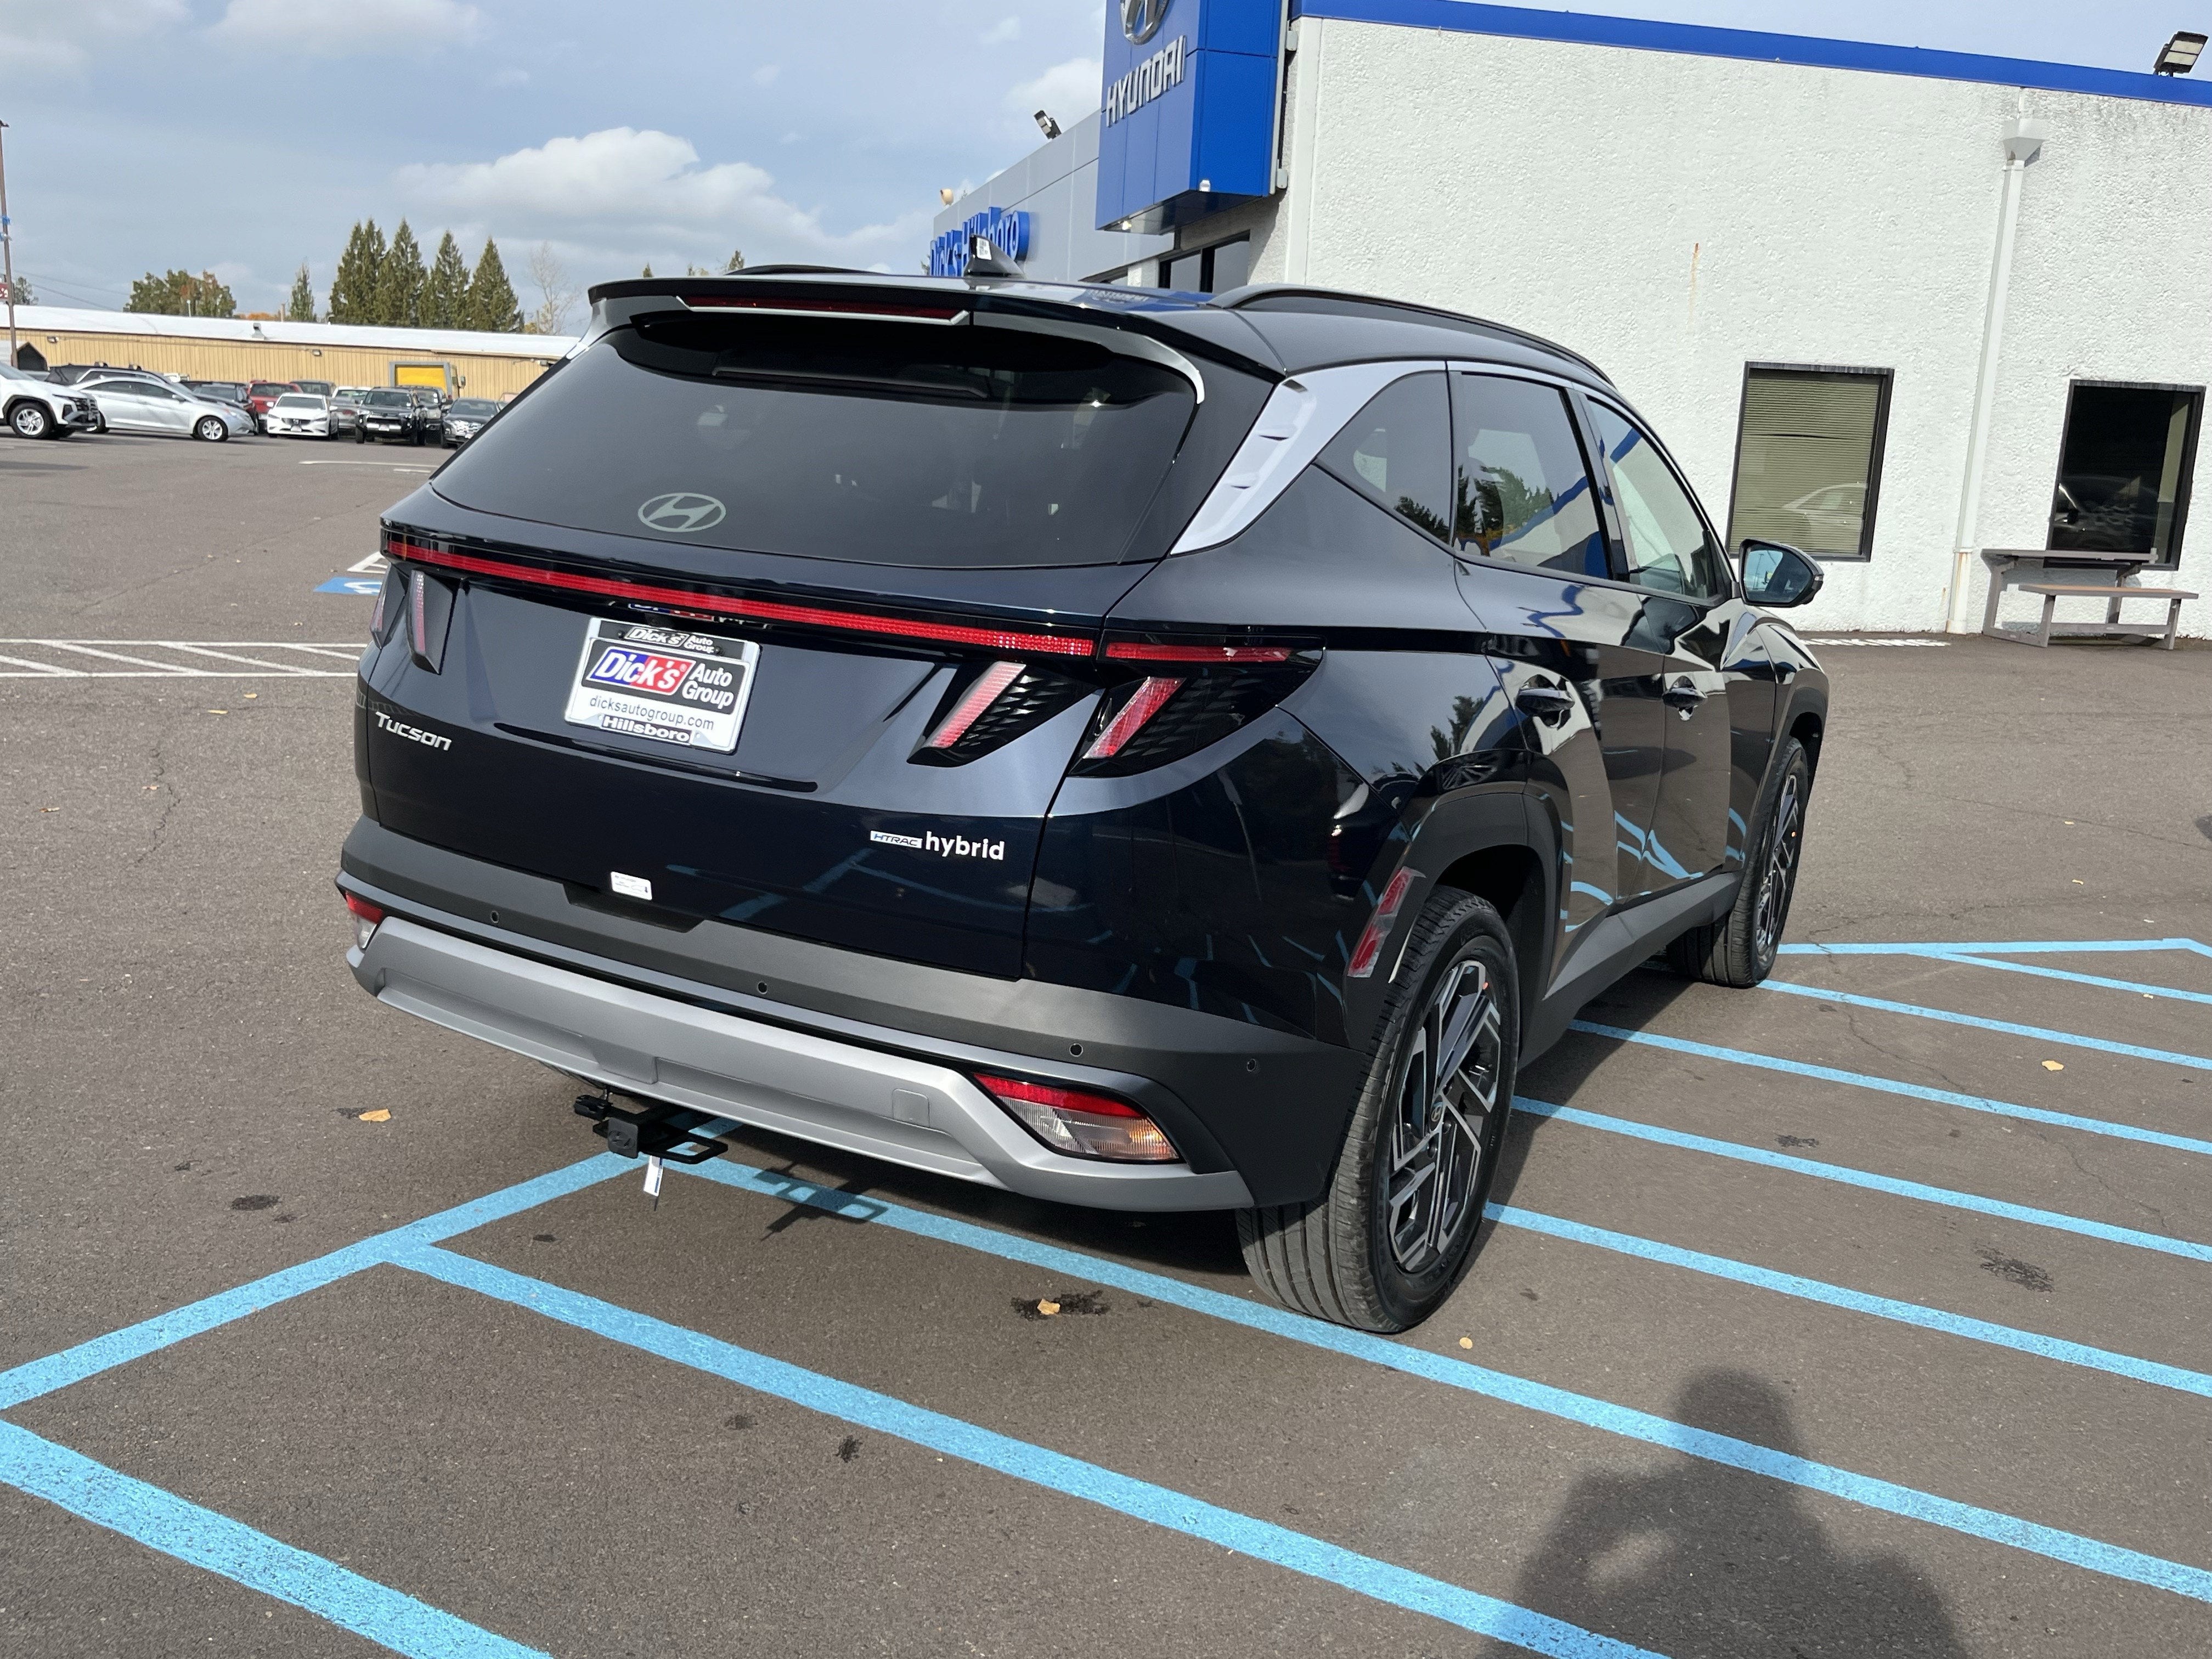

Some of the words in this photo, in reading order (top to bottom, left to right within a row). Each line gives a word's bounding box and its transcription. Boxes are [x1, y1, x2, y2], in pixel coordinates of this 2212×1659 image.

[1106, 35, 1186, 127] HYUNDAI
[962, 207, 1026, 277] Hboro
[629, 629, 679, 645] Dick's
[688, 635, 713, 646] Auto
[683, 643, 715, 653] Group
[595, 651, 681, 690] Dick's
[689, 663, 733, 687] Auto
[682, 682, 734, 709] Group
[590, 695, 714, 730] dicksautogroup.com
[603, 716, 690, 741] Hillsboro
[375, 711, 452, 751] Tucson
[873, 833, 918, 846] HTRAC
[926, 831, 1005, 860] hybrid
